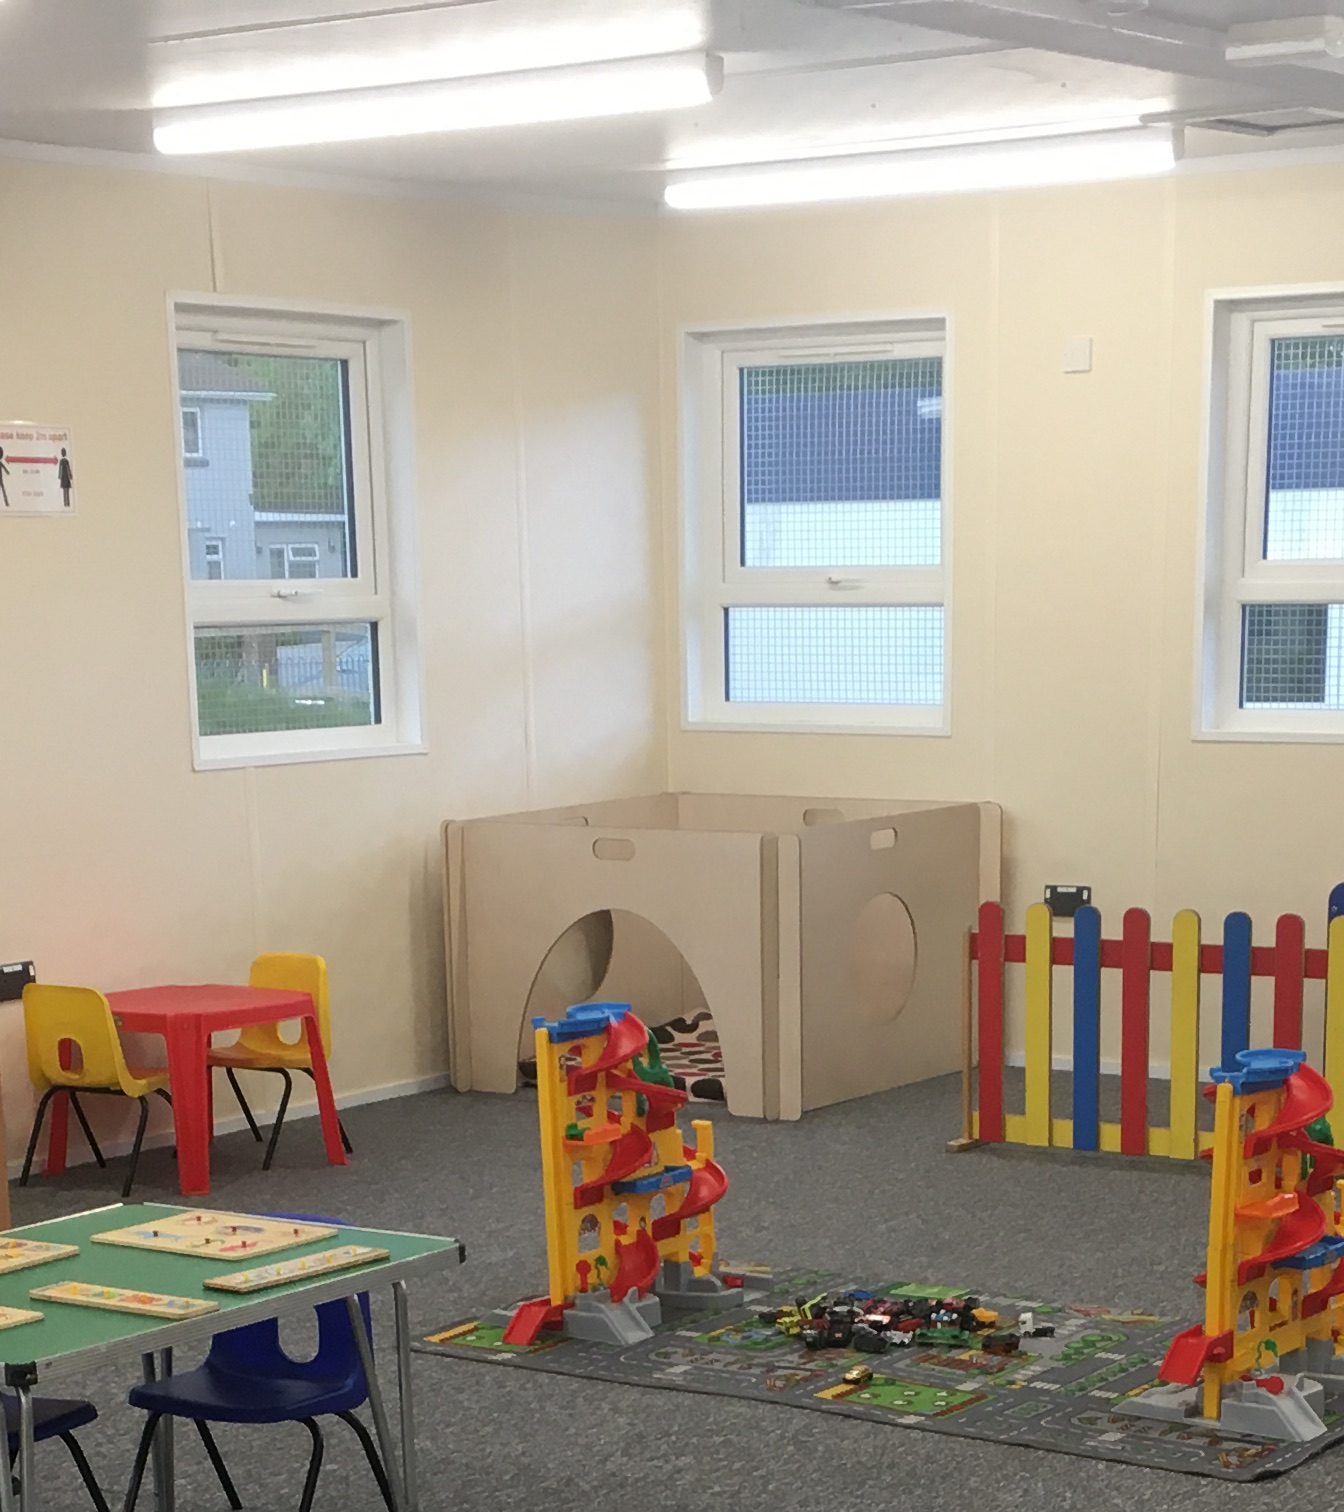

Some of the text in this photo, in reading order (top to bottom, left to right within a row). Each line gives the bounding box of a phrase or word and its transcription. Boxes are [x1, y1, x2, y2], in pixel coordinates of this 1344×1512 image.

[16, 430, 34, 442] keep
[36, 431, 48, 441] 2m
[49, 431, 68, 443] apart
